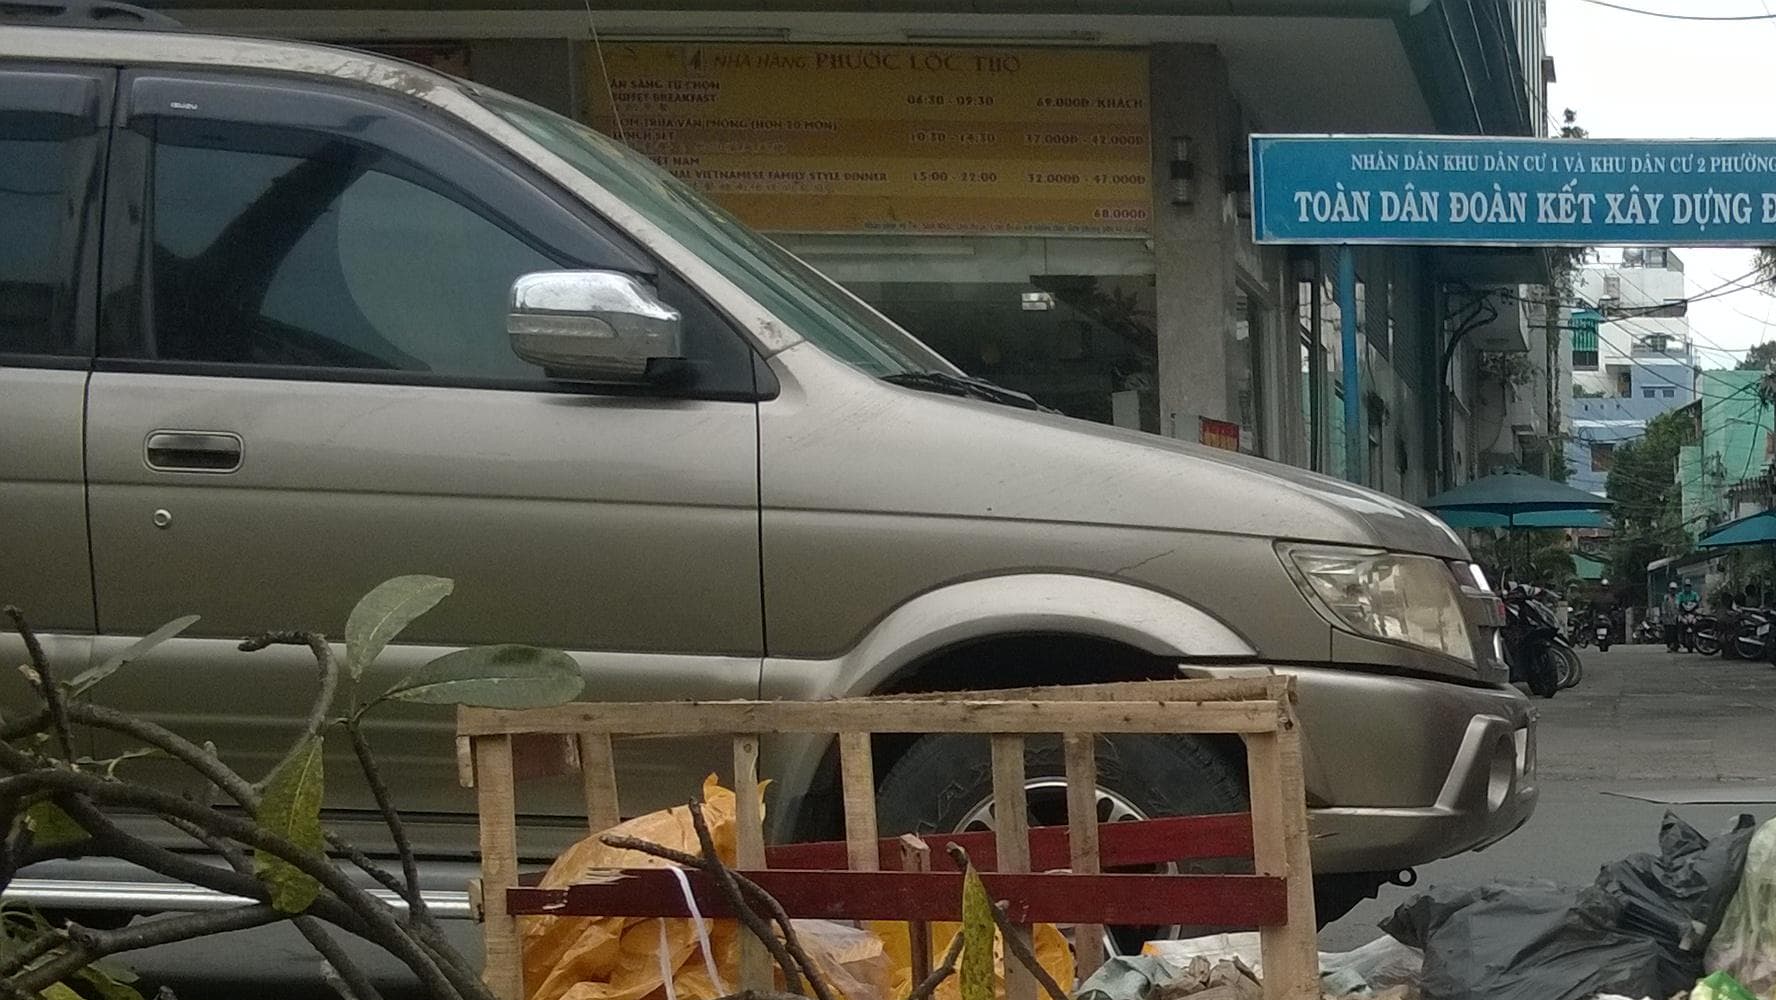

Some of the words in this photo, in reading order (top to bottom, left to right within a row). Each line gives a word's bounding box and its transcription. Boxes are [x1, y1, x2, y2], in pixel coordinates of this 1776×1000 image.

[1351, 150, 1400, 171] NHÂN
[1403, 150, 1439, 171] DÂN
[1443, 154, 1480, 171] KHU
[1483, 151, 1520, 172] DÂN
[1523, 152, 1547, 172] CƯ
[1551, 157, 1559, 172] 1
[1564, 152, 1587, 173] VÀ
[1591, 155, 1626, 173] KHU
[1630, 152, 1666, 173] DÂN
[1670, 153, 1694, 173] CƯ
[1697, 157, 1706, 173] 2
[1294, 182, 1371, 224] TOÀN
[1380, 183, 1439, 224] DÂN
[1449, 183, 1527, 224] ĐOÀN
[1537, 178, 1596, 225] KẾT
[1604, 184, 1663, 225] XÂY
[1672, 190, 1753, 231] DỰNG
